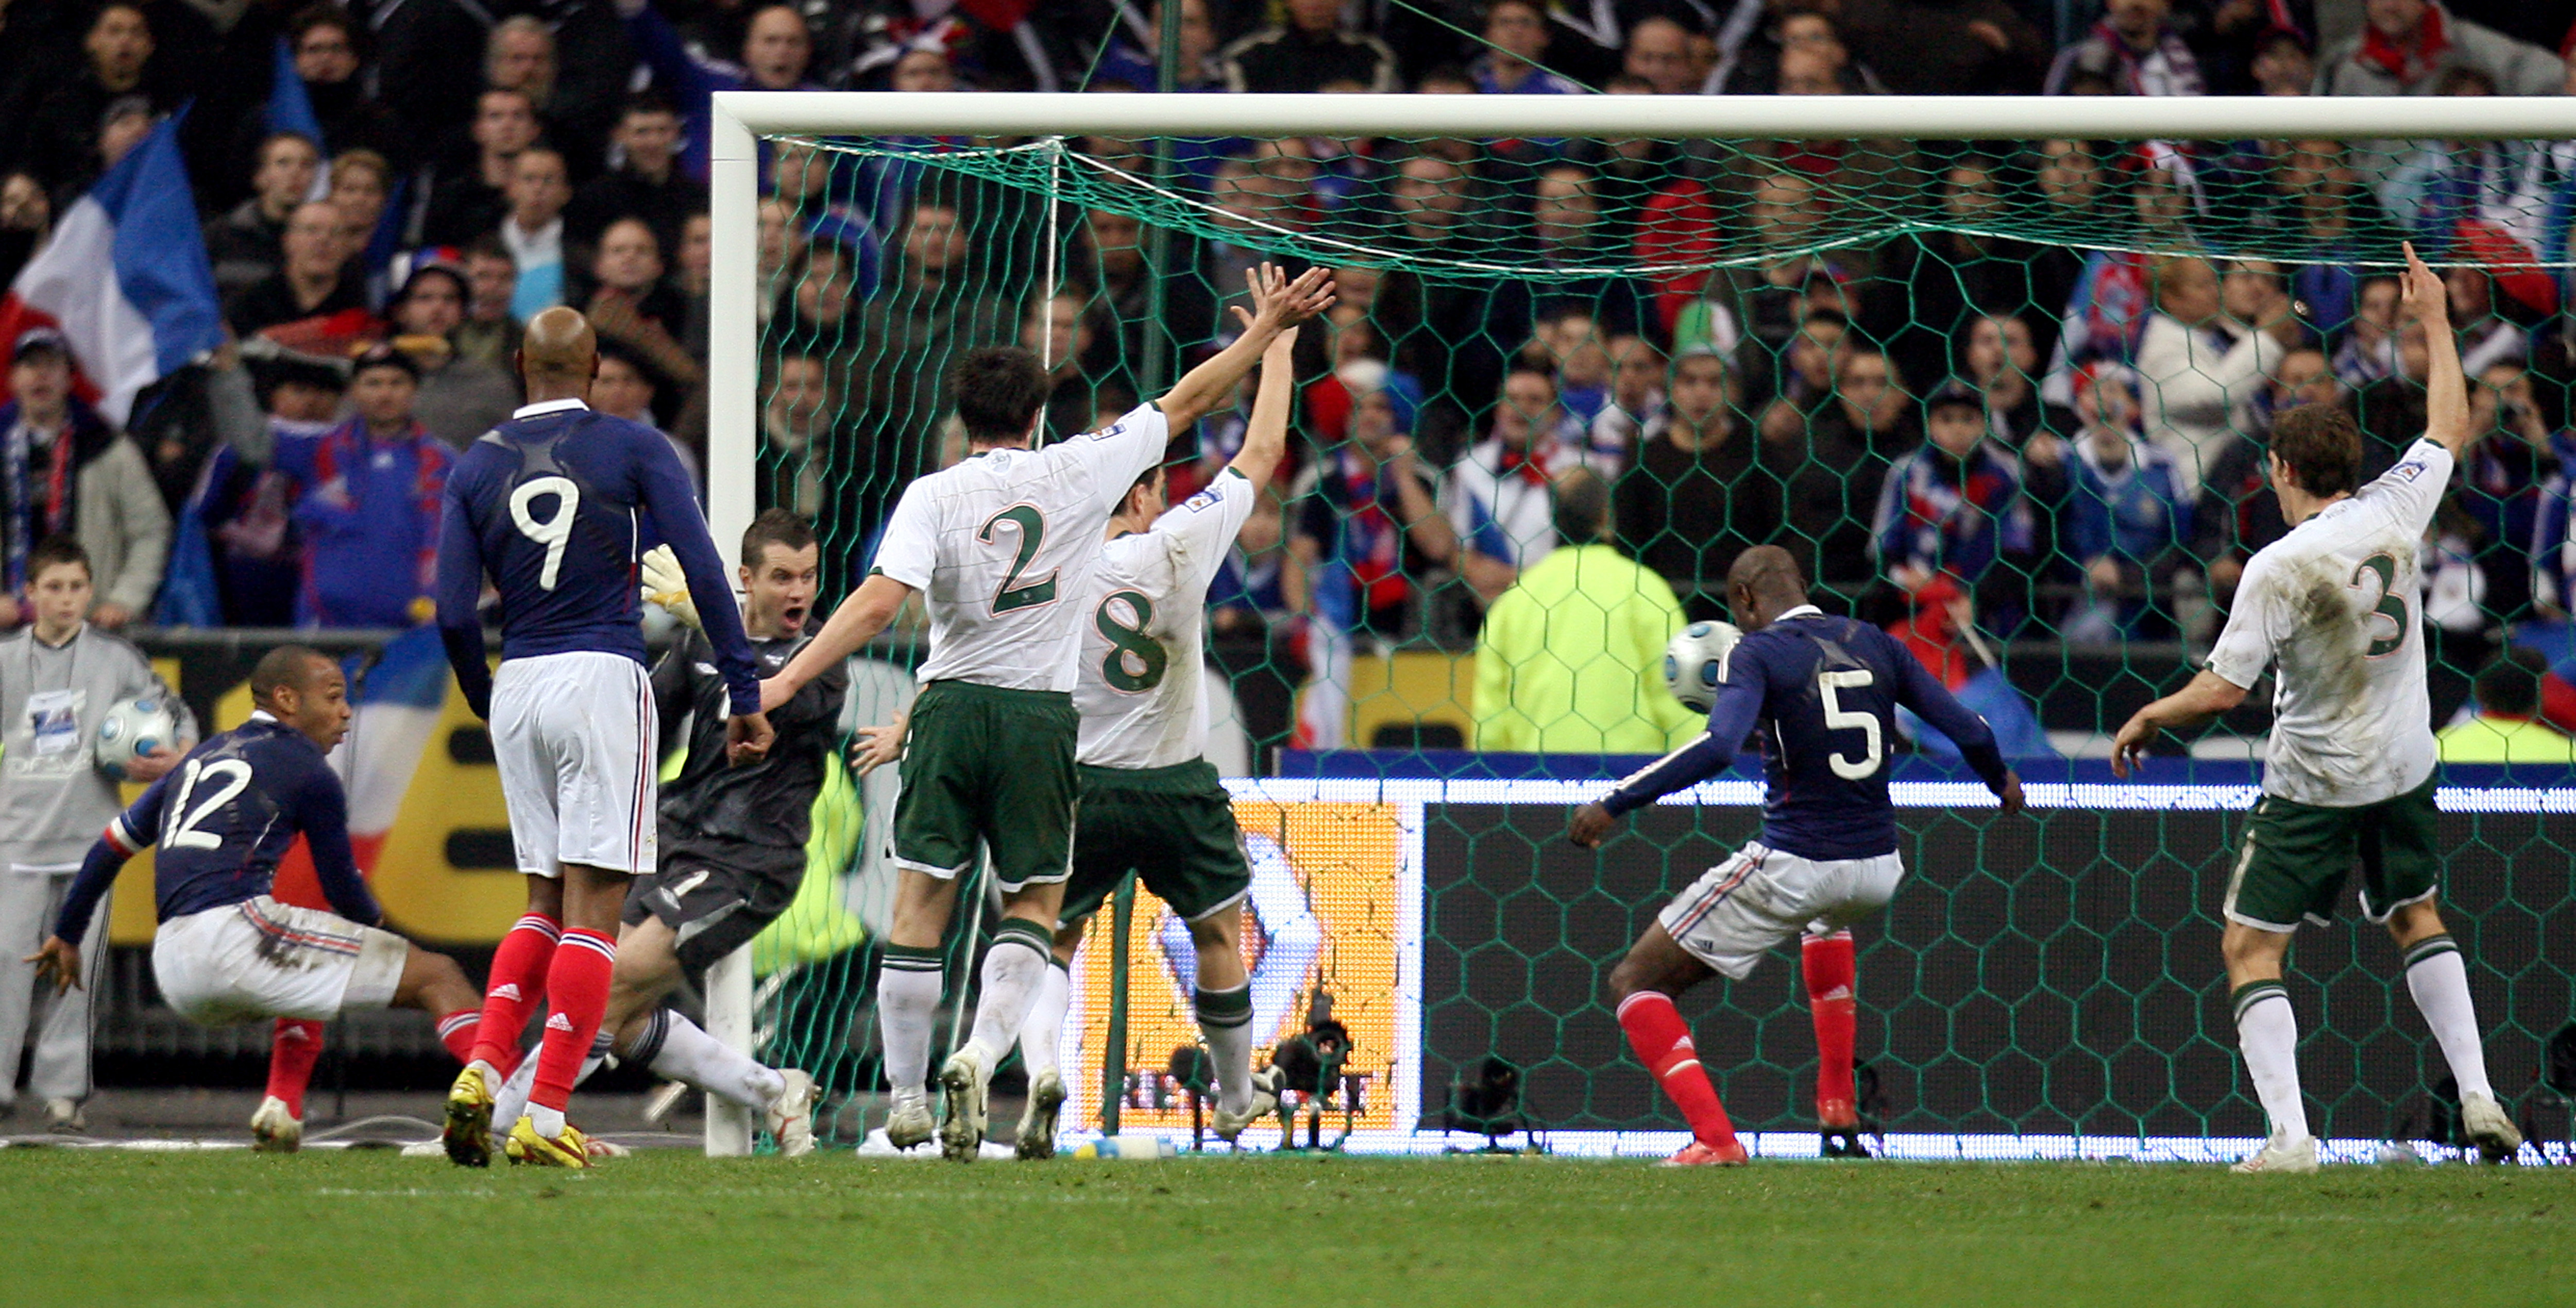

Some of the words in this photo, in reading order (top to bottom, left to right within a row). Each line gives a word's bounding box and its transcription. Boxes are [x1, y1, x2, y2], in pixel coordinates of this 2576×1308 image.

[509, 475, 580, 592] 9
[977, 502, 1061, 618] 2
[1093, 587, 1170, 695] 8
[2348, 550, 2410, 661] 3
[1818, 668, 1882, 780] 5
[163, 758, 252, 851] 12
